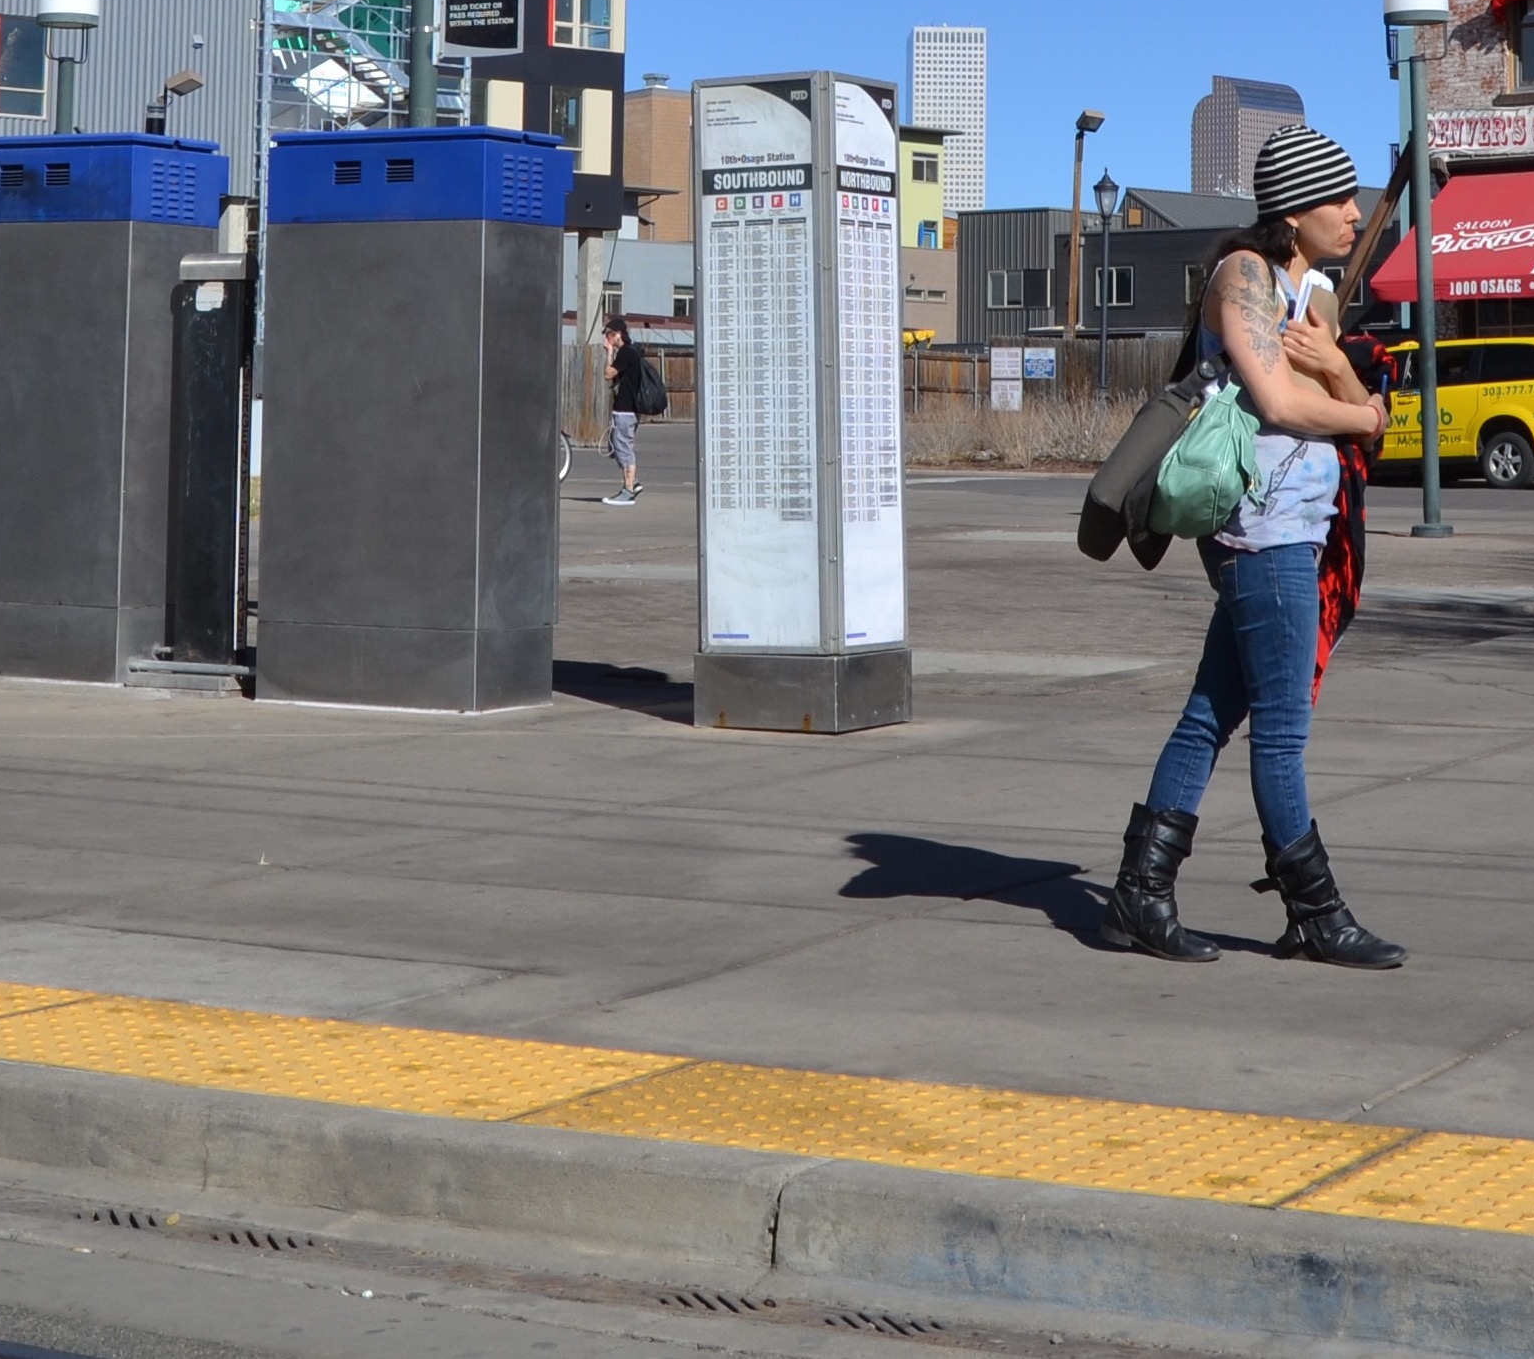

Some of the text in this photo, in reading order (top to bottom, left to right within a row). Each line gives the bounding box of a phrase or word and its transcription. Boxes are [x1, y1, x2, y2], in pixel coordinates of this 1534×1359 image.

[449, 4, 468, 12] VALID
[469, 2, 492, 11] TICKET
[449, 10, 500, 19] PASS REQUIRED
[449, 17, 515, 27] WITHIN THE STATION
[767, 152, 795, 162] Station
[713, 169, 805, 190] SOUTHBOUND
[840, 170, 892, 193] NORTHBOUND
[1453, 219, 1512, 231] SALOON
[1449, 280, 1477, 296] 1000
[1481, 279, 1522, 294] OSAGE
